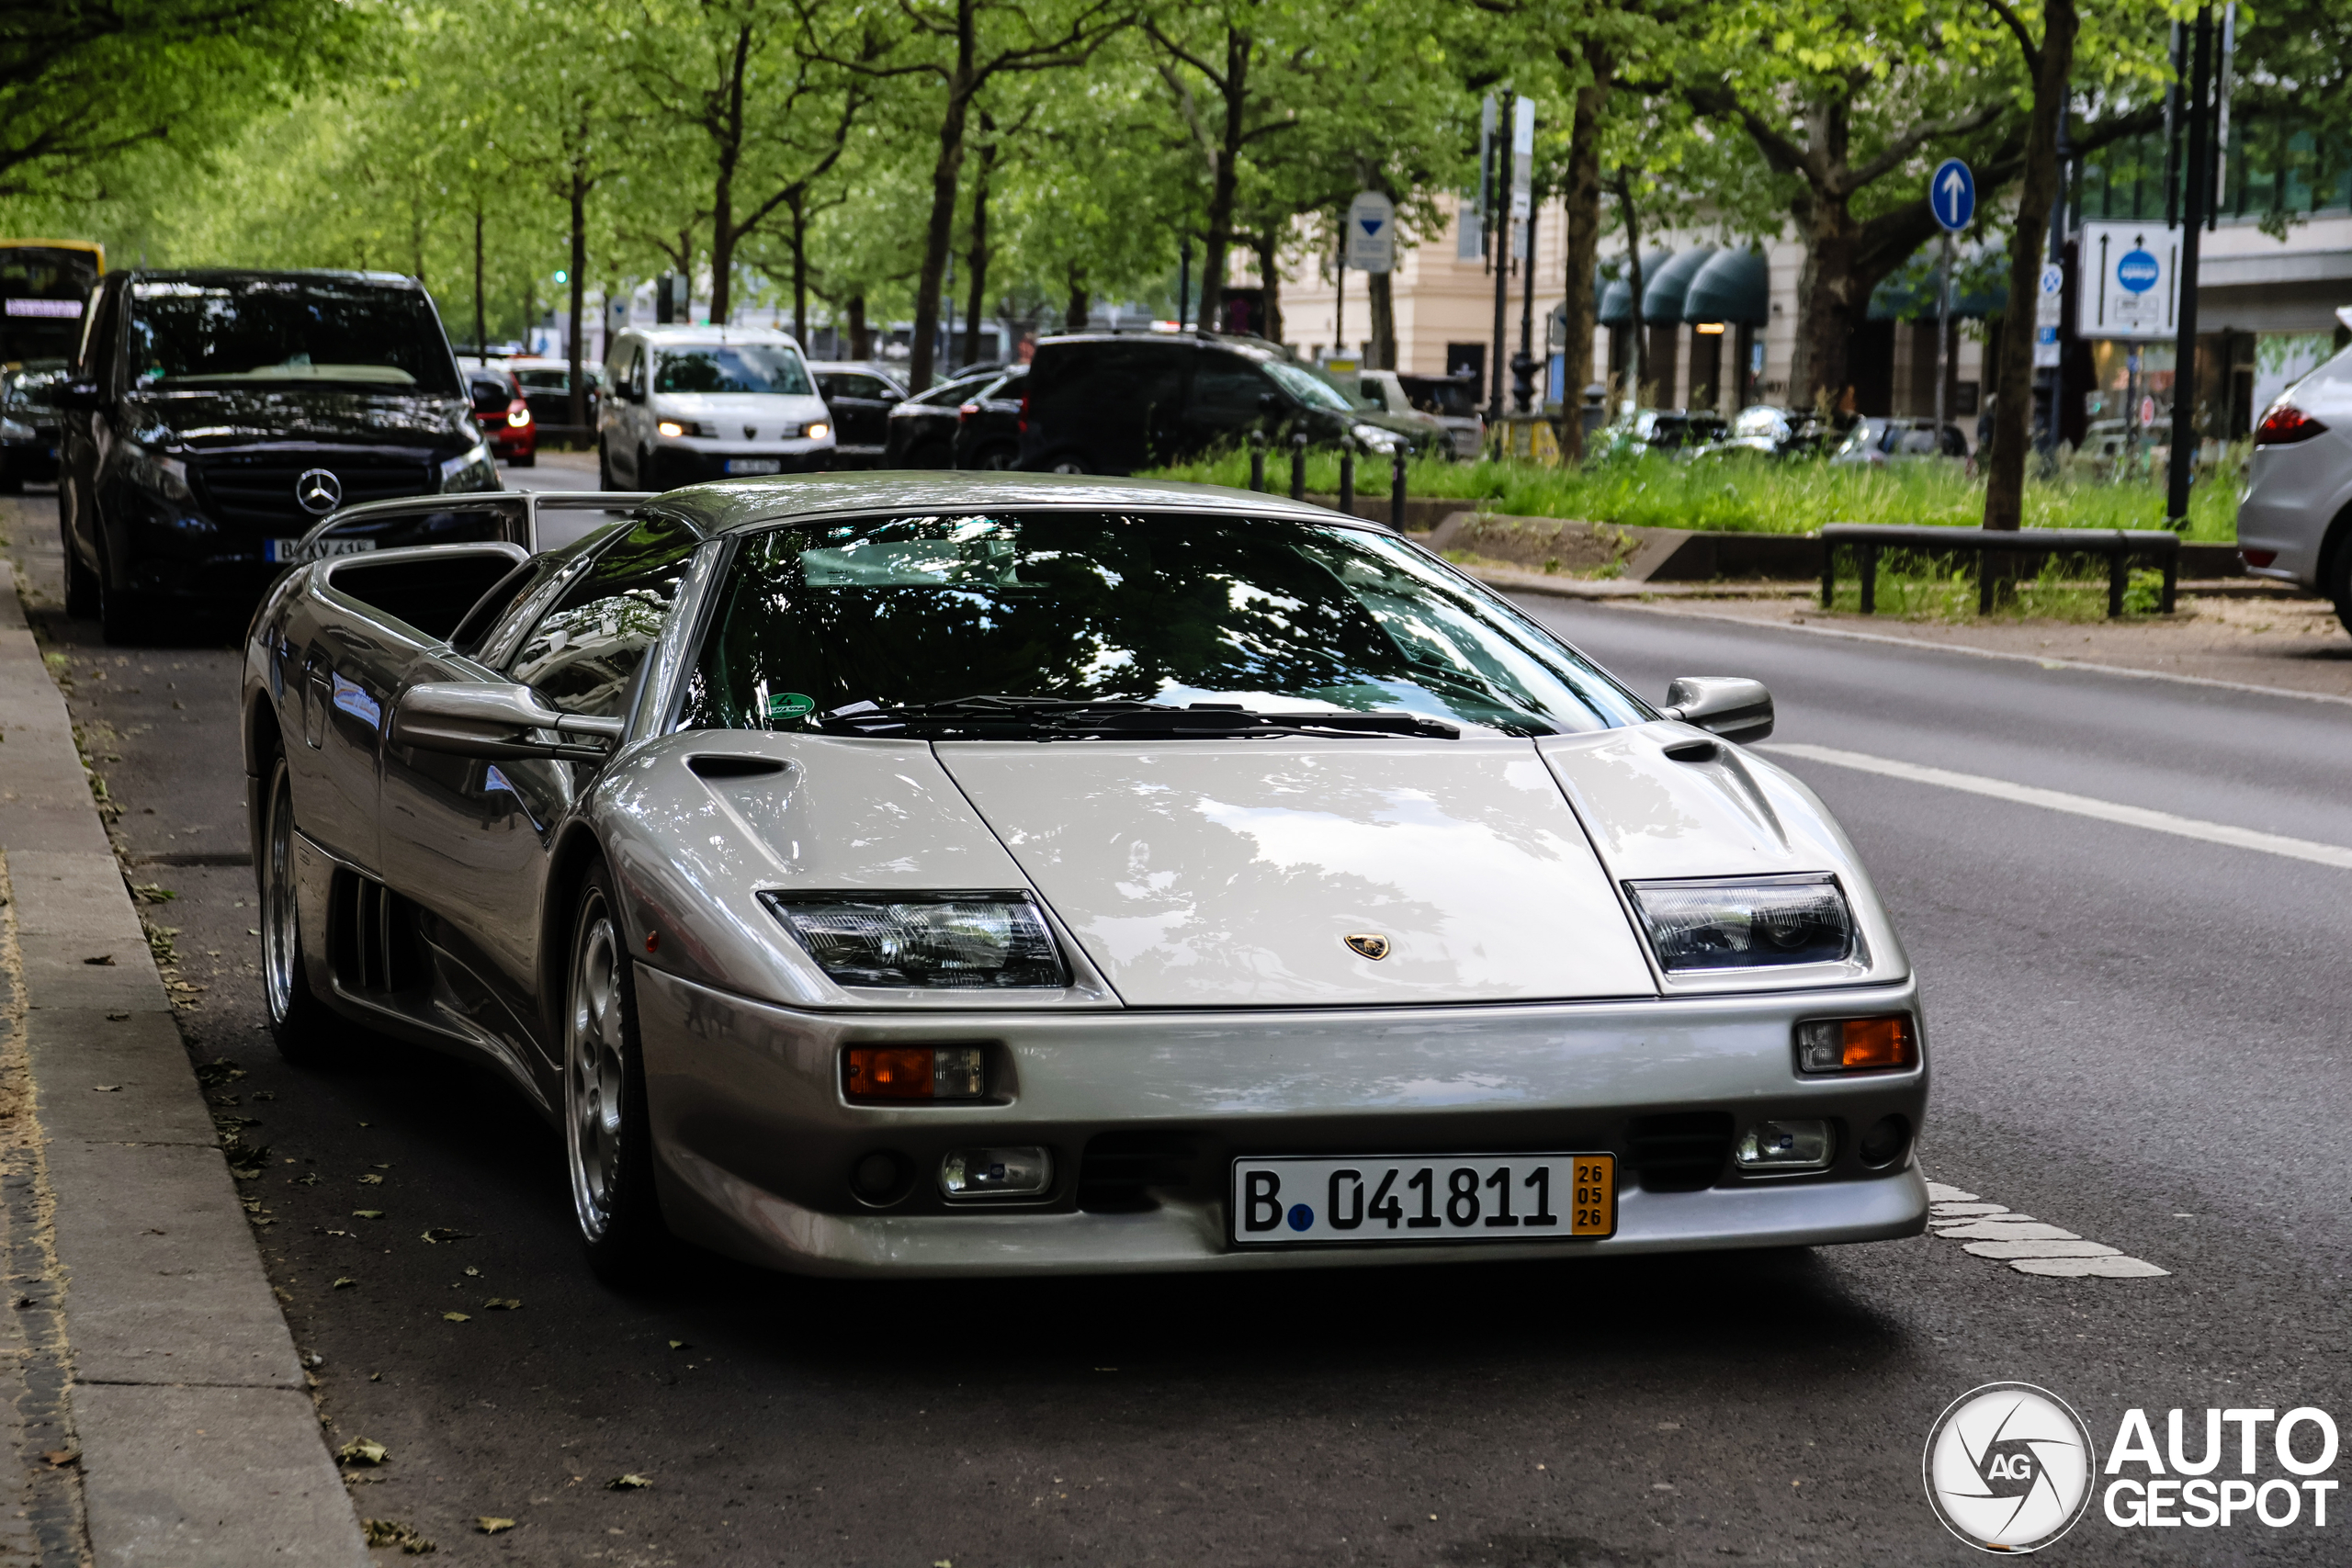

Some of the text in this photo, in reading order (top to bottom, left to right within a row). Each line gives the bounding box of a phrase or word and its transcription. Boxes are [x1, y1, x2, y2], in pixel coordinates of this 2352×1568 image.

[776, 694, 793, 705] 4
[1578, 1165, 1602, 1182] 26
[1246, 1167, 1557, 1232] B 041811
[1577, 1187, 1602, 1204] 05
[1577, 1208, 1601, 1226] 26
